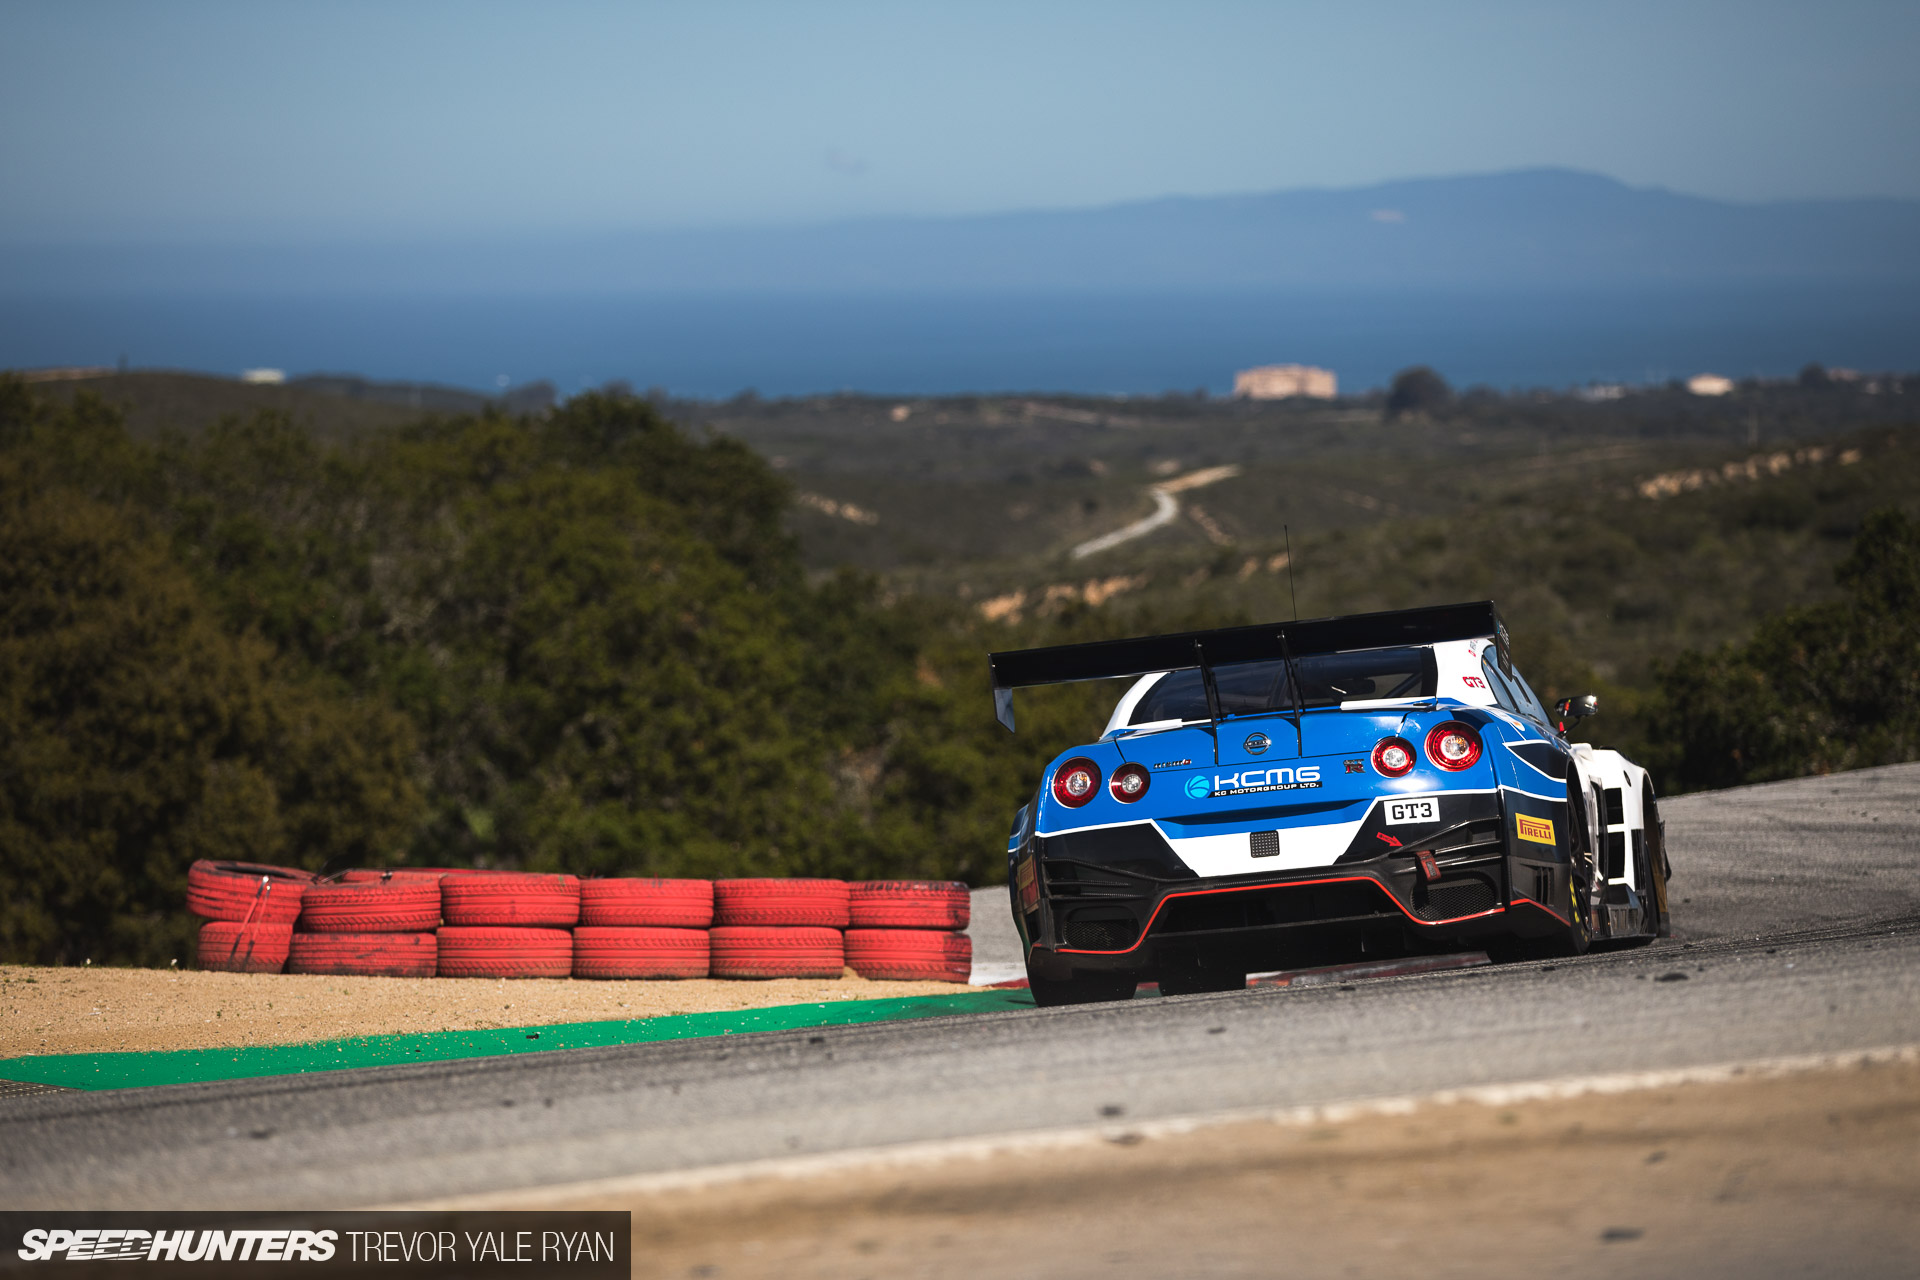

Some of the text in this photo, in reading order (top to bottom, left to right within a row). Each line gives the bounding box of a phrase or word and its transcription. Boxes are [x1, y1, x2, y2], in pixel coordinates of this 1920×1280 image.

[1462, 676, 1485, 688] GT3
[1214, 766, 1321, 790] KCMG
[1230, 784, 1298, 795] MOTORGROUP
[1391, 802, 1433, 820] GT3
[1518, 818, 1552, 840] PIRELLI
